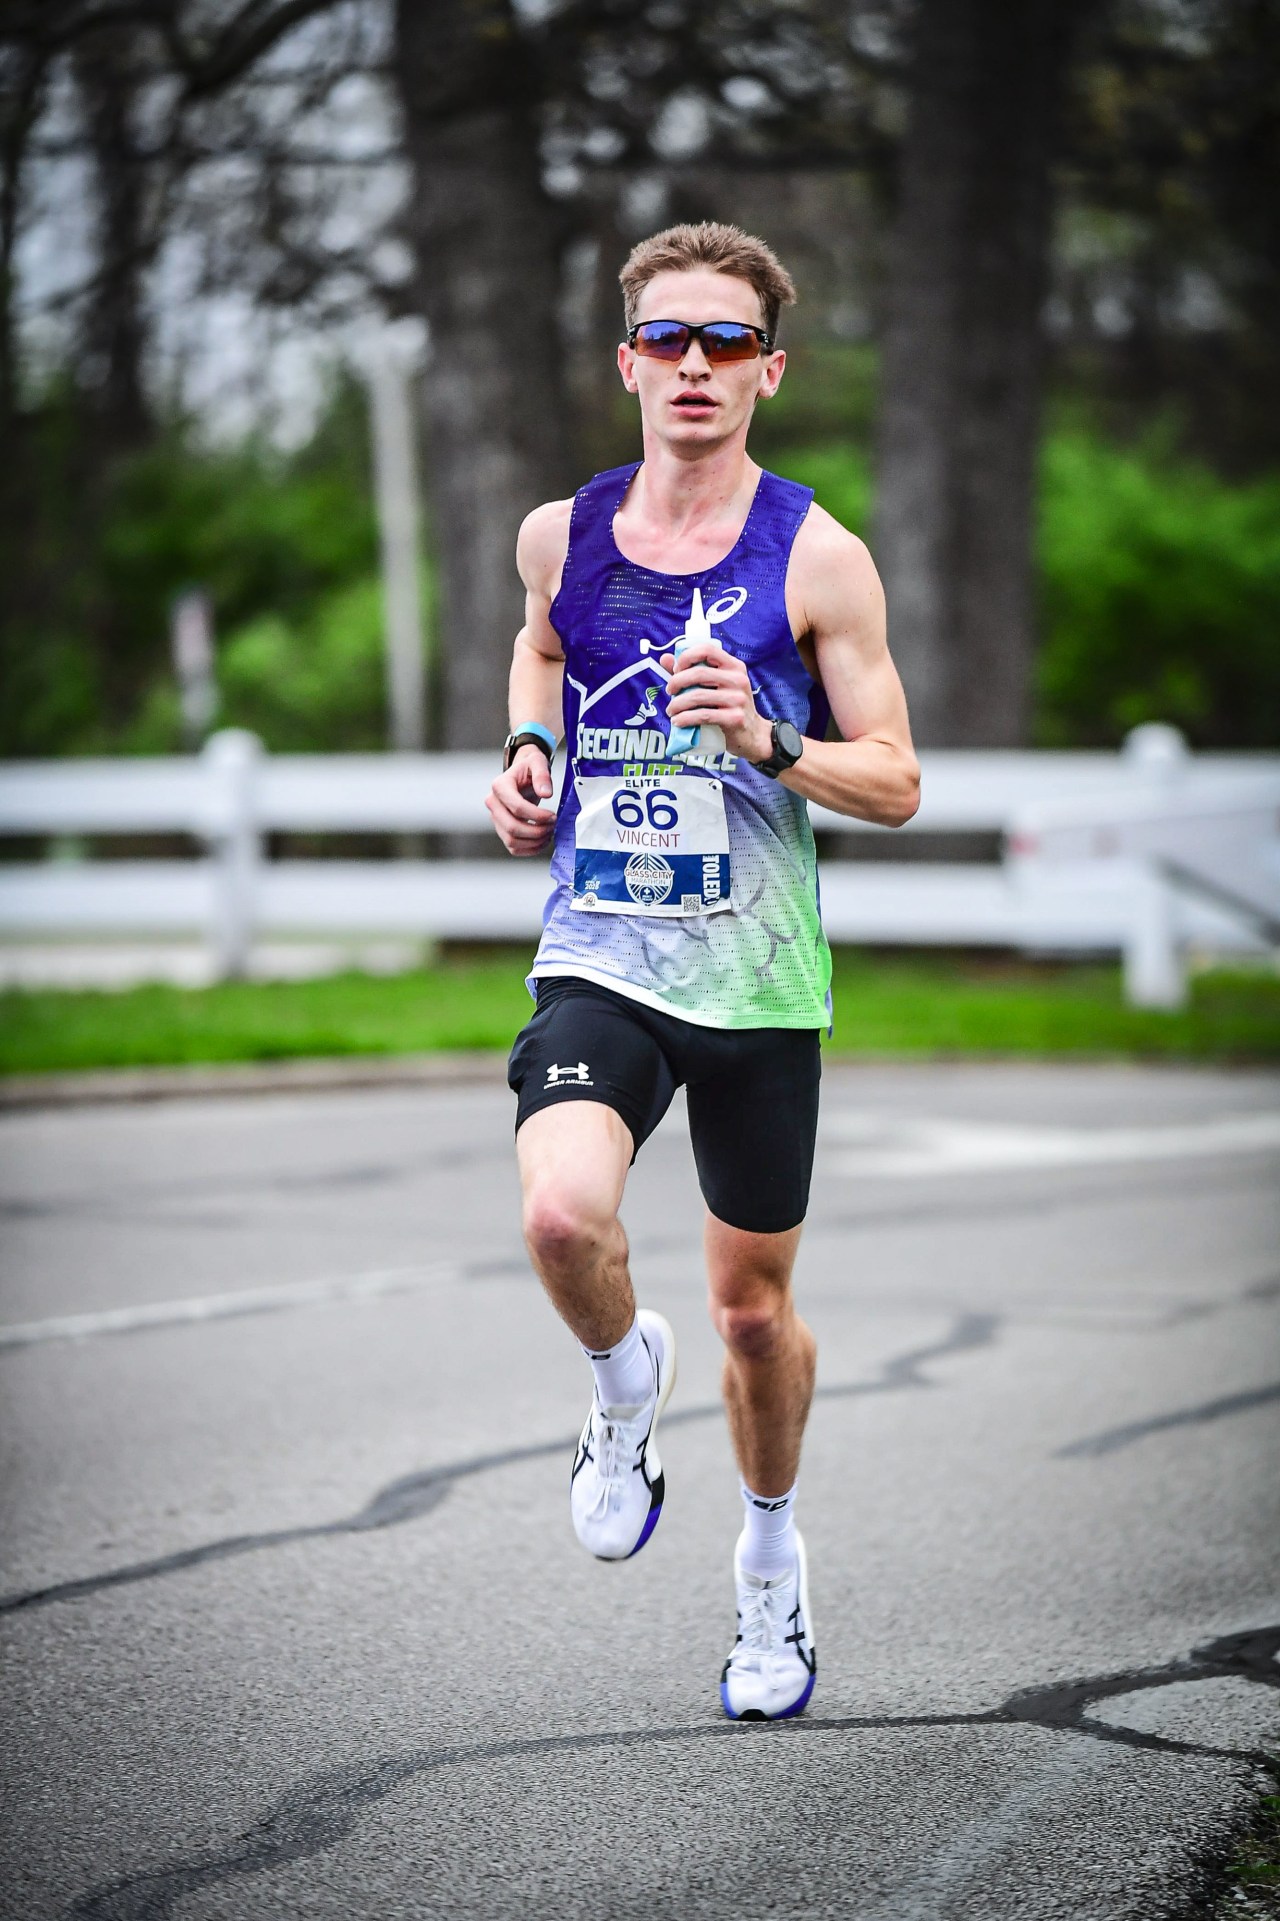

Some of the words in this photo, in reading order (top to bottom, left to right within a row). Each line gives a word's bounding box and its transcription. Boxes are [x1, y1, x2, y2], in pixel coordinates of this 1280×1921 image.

[625, 778, 661, 788] ELITE
[612, 789, 679, 830] 66
[616, 829, 681, 848] VINCENT
[625, 868, 650, 879] GLASS
[652, 871, 673, 879] CITY
[702, 854, 720, 906] TOLEDO
